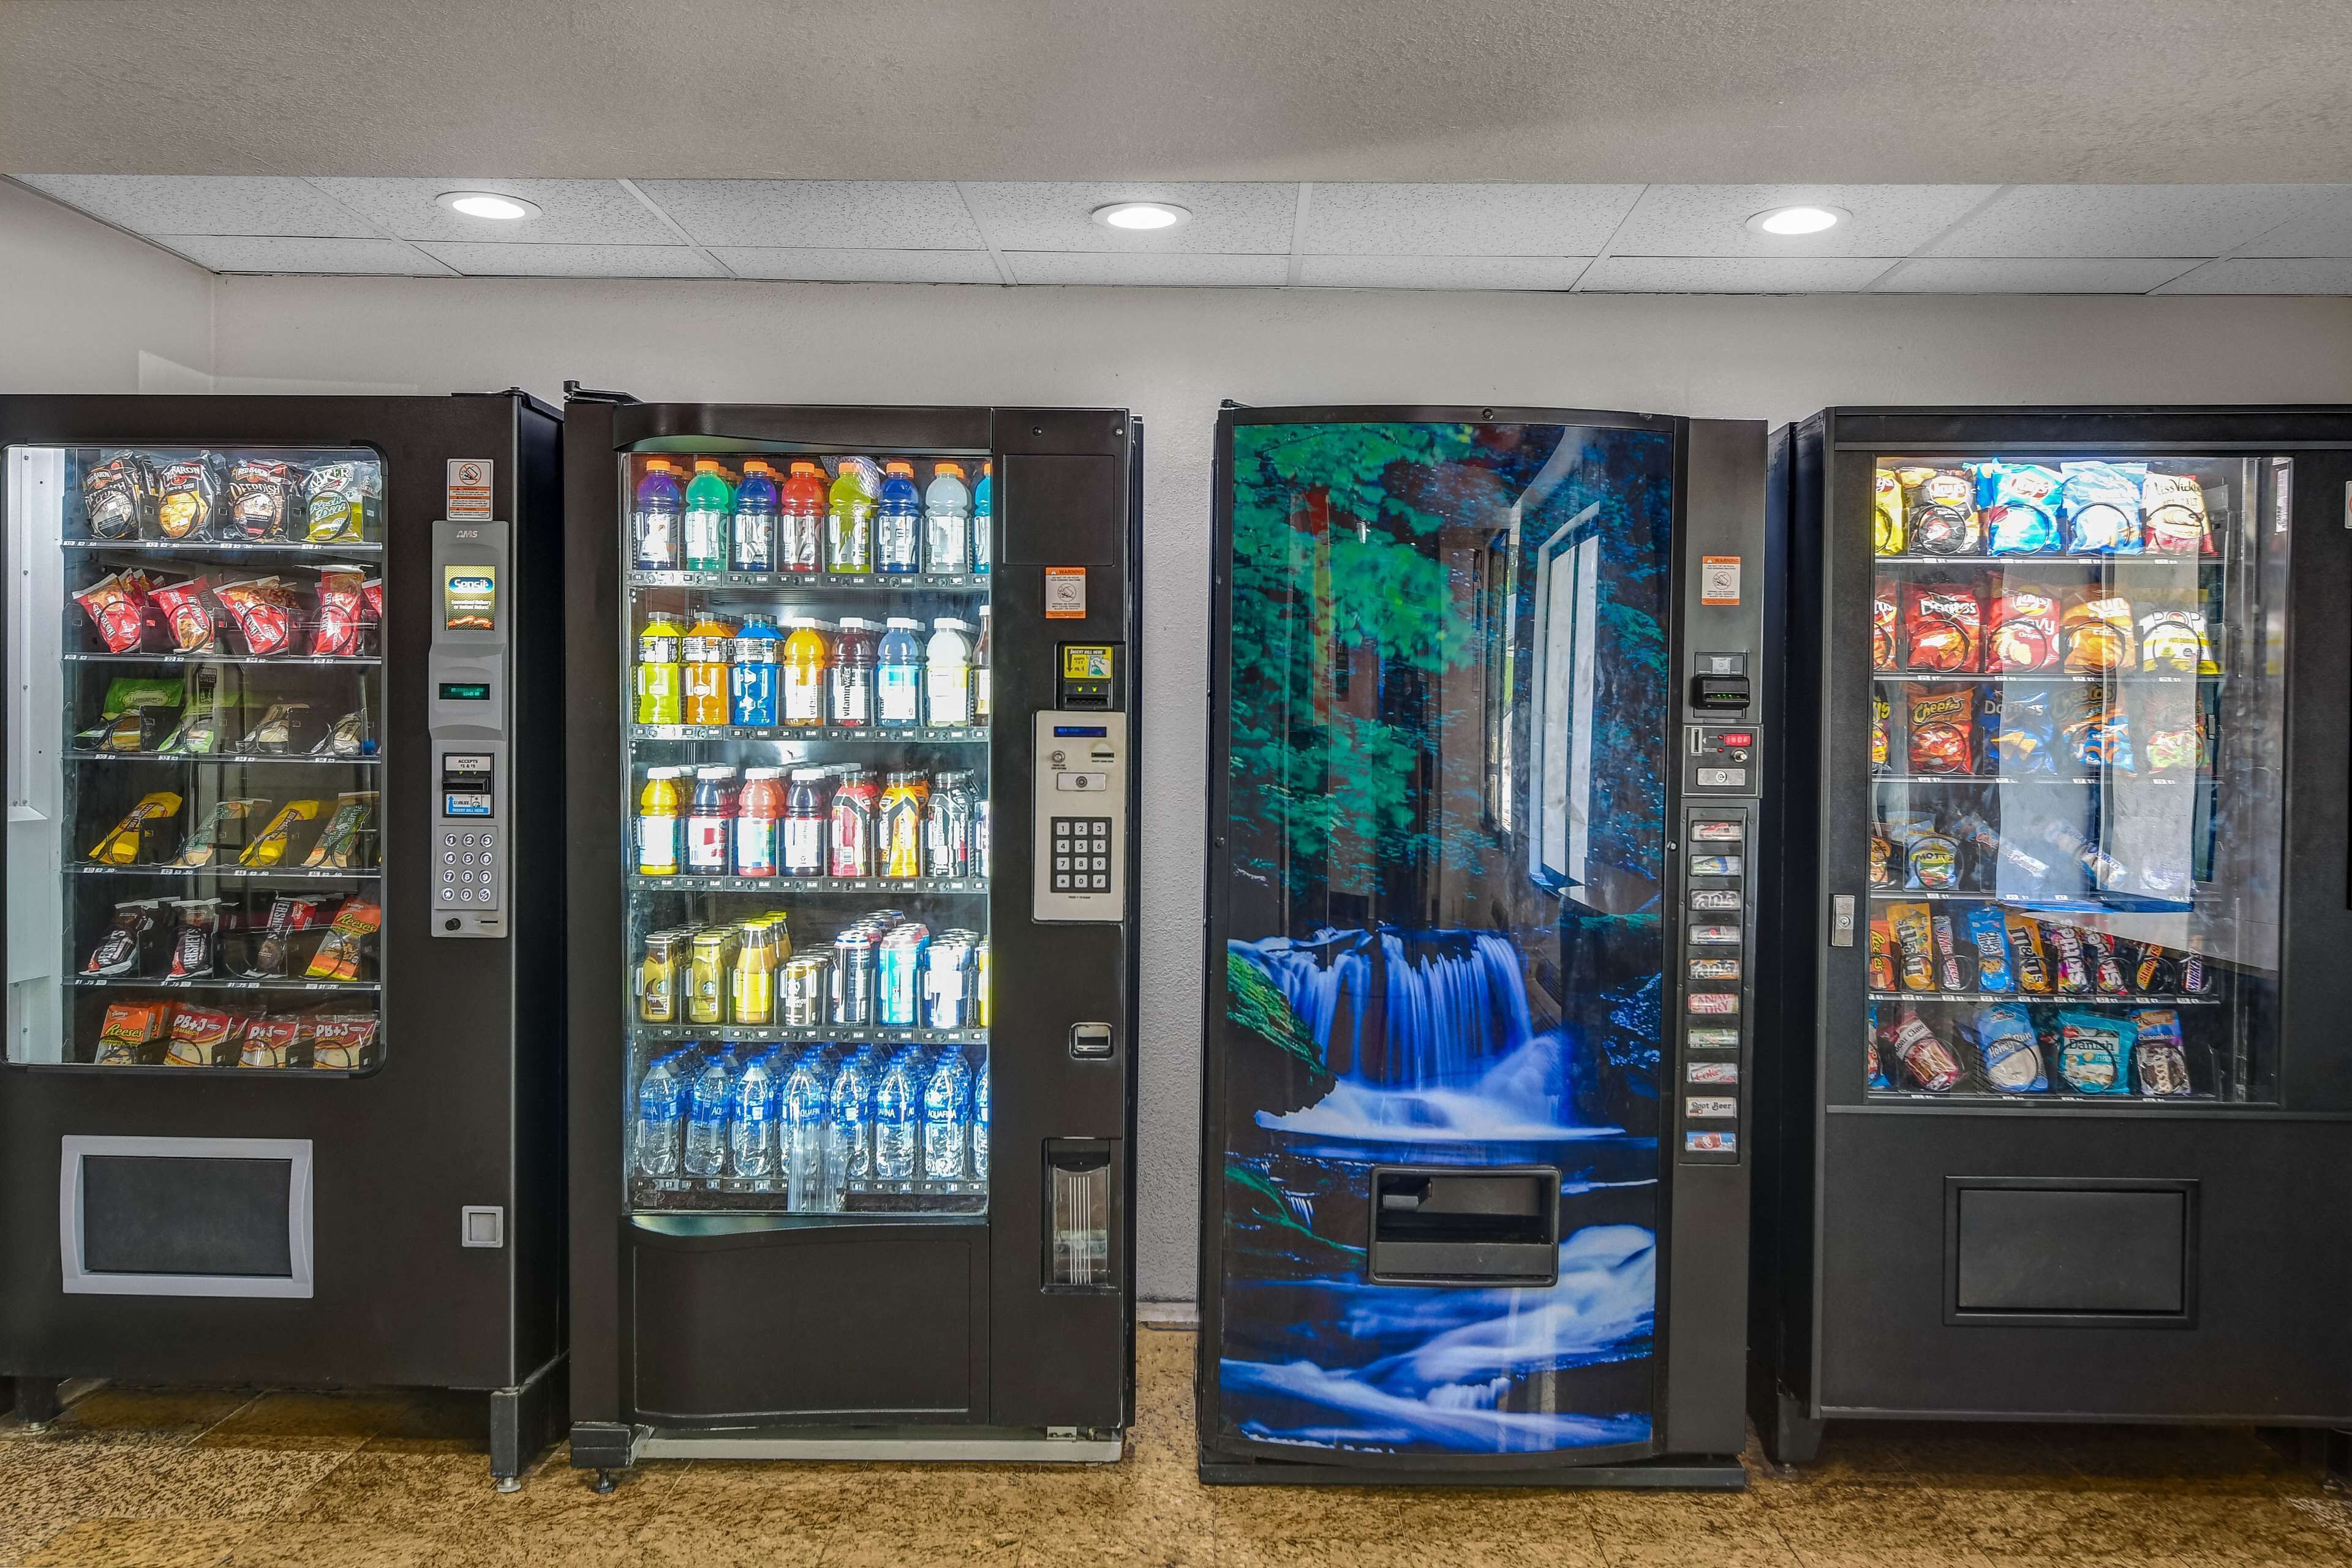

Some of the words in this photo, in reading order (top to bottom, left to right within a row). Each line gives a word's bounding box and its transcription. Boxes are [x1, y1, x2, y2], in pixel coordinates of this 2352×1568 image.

[1912, 697, 1966, 725] Cheetos
[336, 913, 376, 932] Reese's
[1870, 930, 1886, 971] Reee's
[105, 1023, 145, 1038] Reese's
[173, 1014, 206, 1032] PB+J
[315, 1023, 350, 1037] PB+J
[1907, 1020, 1925, 1039] Claw
[249, 1025, 276, 1039] P+J
[2067, 1038, 2115, 1052] Danish
[927, 1109, 957, 1119] AQUAFIA
[1712, 1102, 1732, 1111] Beer
